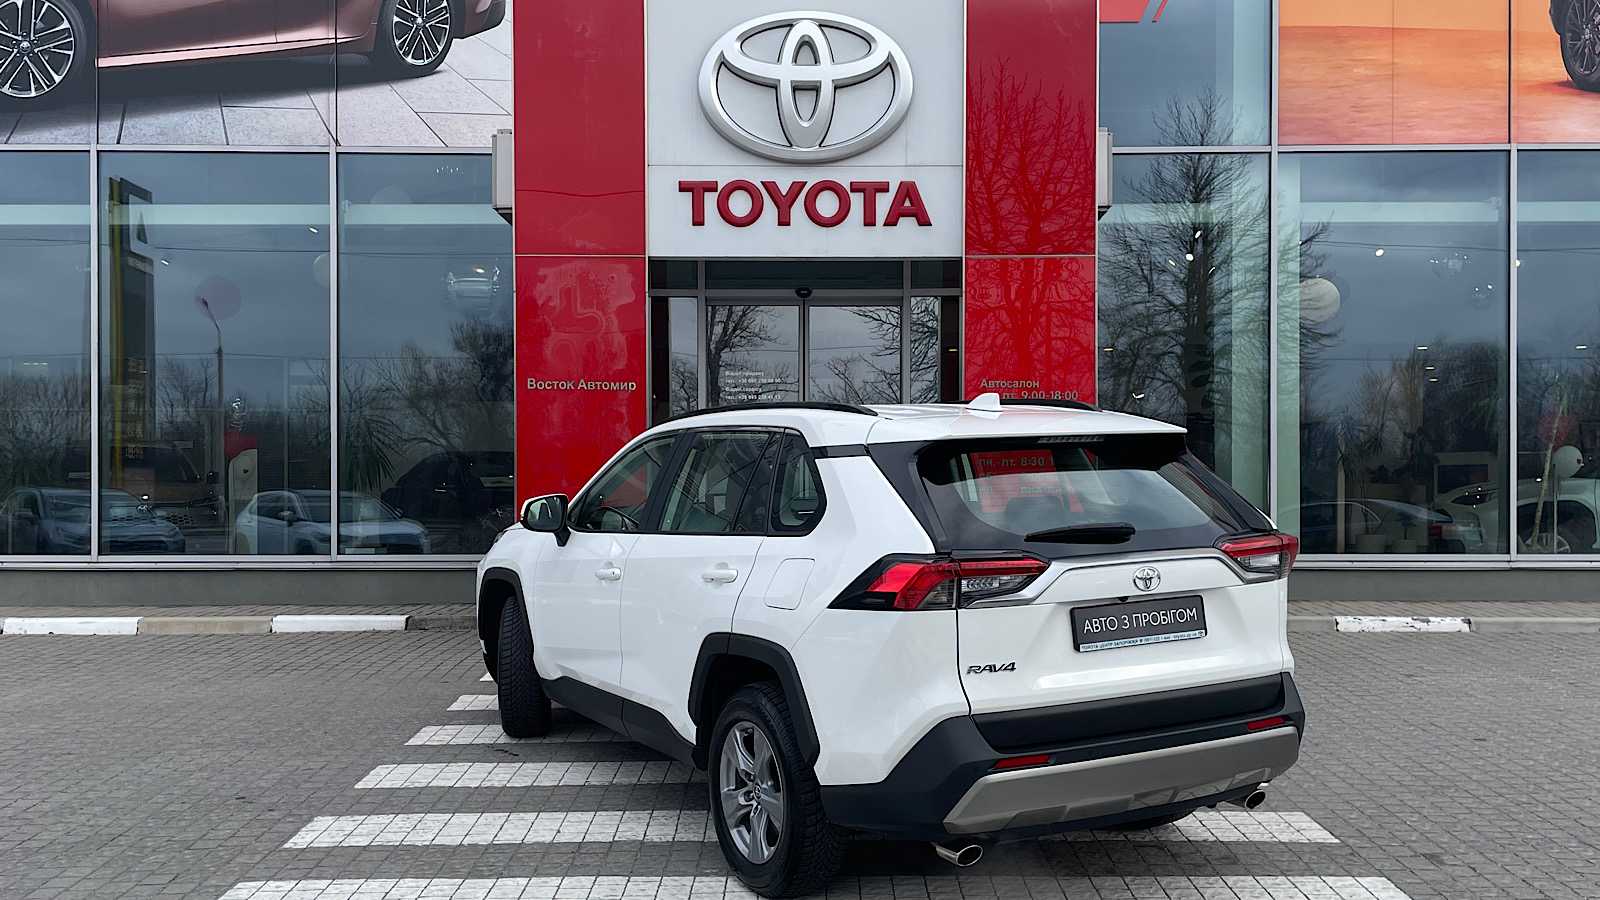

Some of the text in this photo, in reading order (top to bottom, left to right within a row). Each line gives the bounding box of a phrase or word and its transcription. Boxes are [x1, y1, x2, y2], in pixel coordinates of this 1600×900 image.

[678, 179, 933, 227] TOYOTA
[527, 378, 637, 393] Восток Автомир
[980, 379, 1040, 388] Автосалон
[1083, 616, 1118, 633] АВТО
[1132, 607, 1198, 627] ПРОБІГОМ
[966, 661, 1016, 674] RAV4
